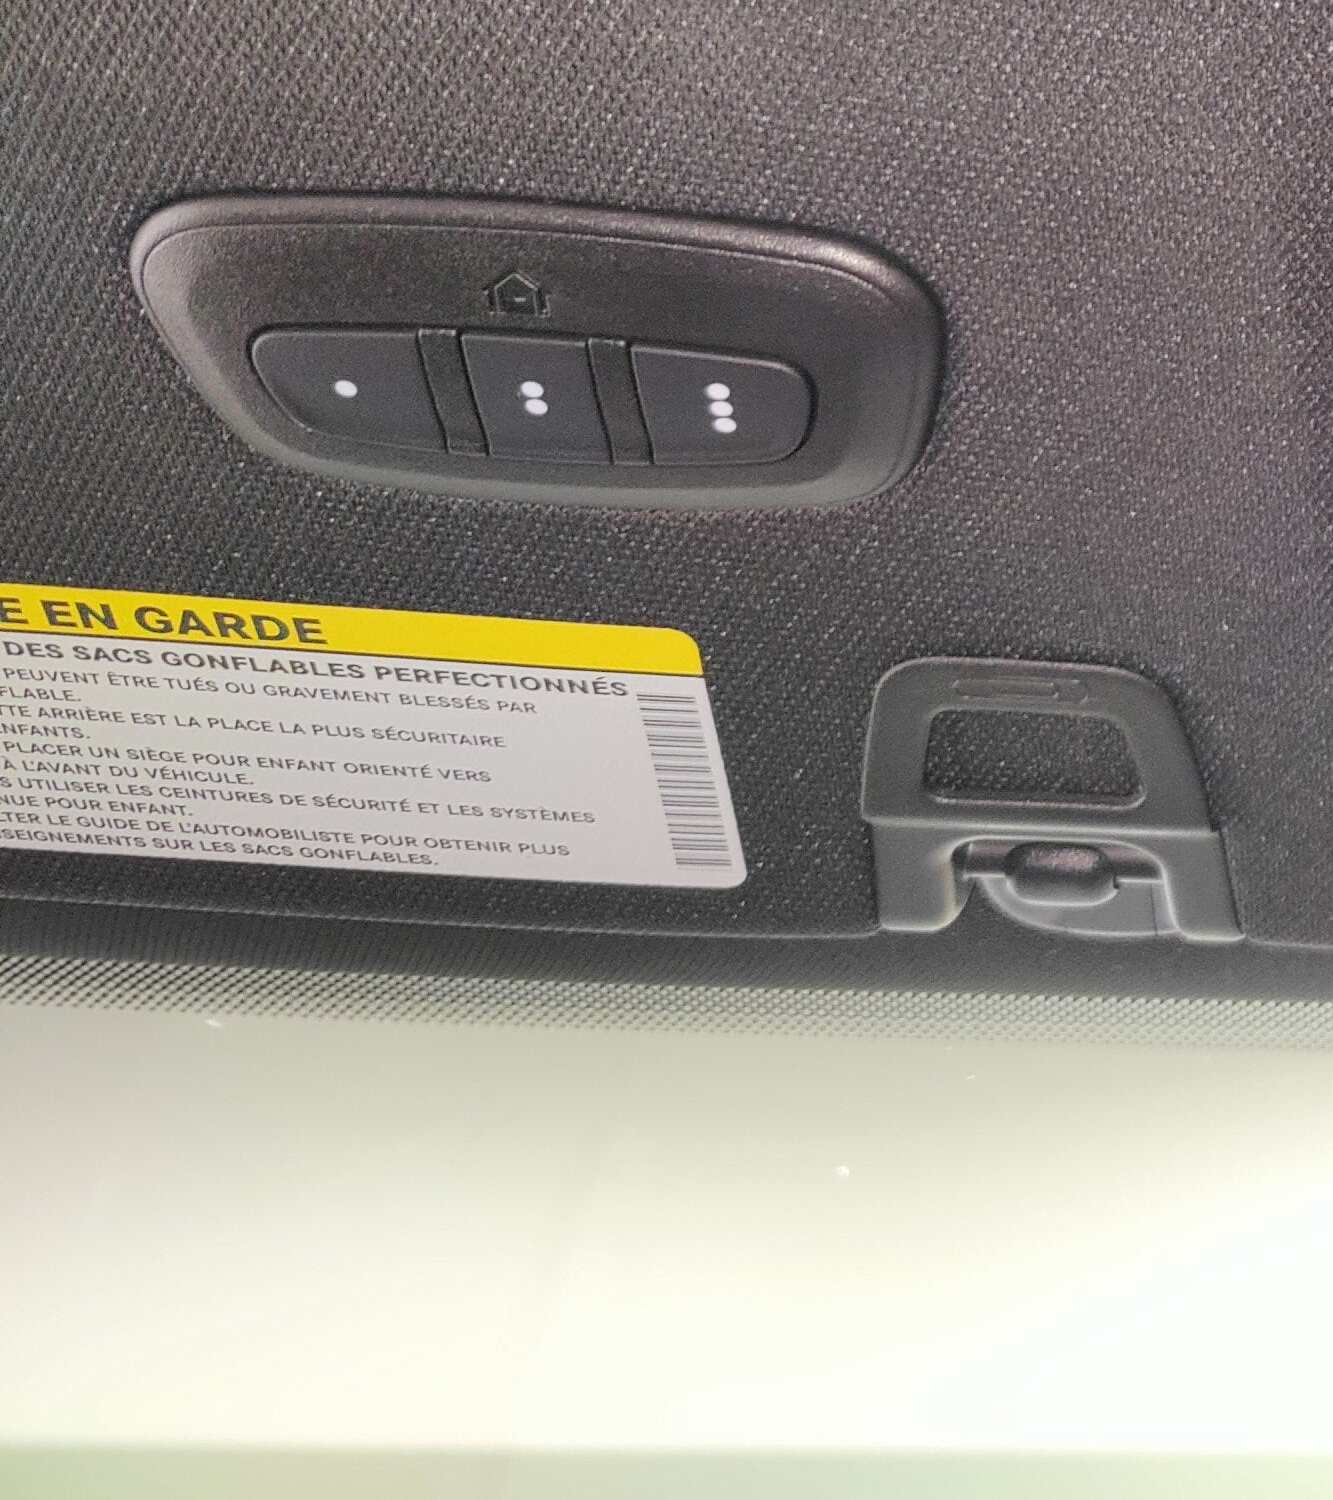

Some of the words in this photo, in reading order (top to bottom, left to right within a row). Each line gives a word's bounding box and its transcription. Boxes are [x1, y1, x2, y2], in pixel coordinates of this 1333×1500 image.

[40, 599, 119, 631] EN
[134, 606, 328, 645] GARDE
[2, 641, 64, 659] DES
[72, 645, 152, 665] SACS
[161, 651, 366, 680] GONFLABLES
[374, 666, 629, 697] PERFECTIONNÉS
[3, 667, 100, 685] PEUVENT
[107, 671, 160, 689] ÊTRE
[164, 677, 219, 693] TUÉS
[225, 681, 255, 694] OU
[263, 684, 391, 704] GRAVEMENT
[399, 693, 491, 711] BLESSÉS
[497, 700, 537, 714] PAR
[0, 722, 91, 739] NFANTS.
[38, 706, 126, 723] ARRIÈRE
[131, 712, 166, 726] EST
[174, 715, 201, 729] LA
[208, 717, 274, 732] PLACE
[279, 722, 306, 735] LA
[312, 724, 365, 739] PLUS
[371, 726, 507, 748] SÉCURITAIRE
[3, 741, 84, 757] PLACER
[88, 746, 120, 759] UN
[126, 747, 188, 763] SIÈGE
[192, 753, 251, 767] POUR
[256, 757, 336, 772] ENFANT
[343, 762, 433, 779] ORIENTÉ
[438, 768, 492, 782] VERS
[22, 760, 101, 777] L'AVANT
[108, 765, 138, 778] DU
[144, 766, 254, 785] VÉHICULE.
[18, 777, 110, 794] UTILISER
[116, 784, 153, 797] LES
[159, 786, 273, 804] CEINTURES
[280, 794, 307, 806] DE
[313, 794, 412, 812] SÉCURITÉ
[417, 802, 439, 814] ET
[447, 804, 484, 817] LES
[489, 807, 596, 823] SYSTÈMES
[44, 797, 104, 811] POUR
[108, 801, 194, 817] ENFANT.
[47, 814, 72, 827] LE
[76, 816, 142, 831] GUIDE
[146, 820, 174, 833] DE
[179, 822, 356, 844] L'AUTOMOBILISTE
[361, 833, 419, 848] POUR
[423, 837, 512, 853] OBTENIR
[518, 843, 570, 856] PLUS
[152, 837, 195, 850] SUR
[200, 840, 237, 853] LES
[242, 843, 294, 857] SACS
[300, 847, 438, 866] GONFLABLES.
